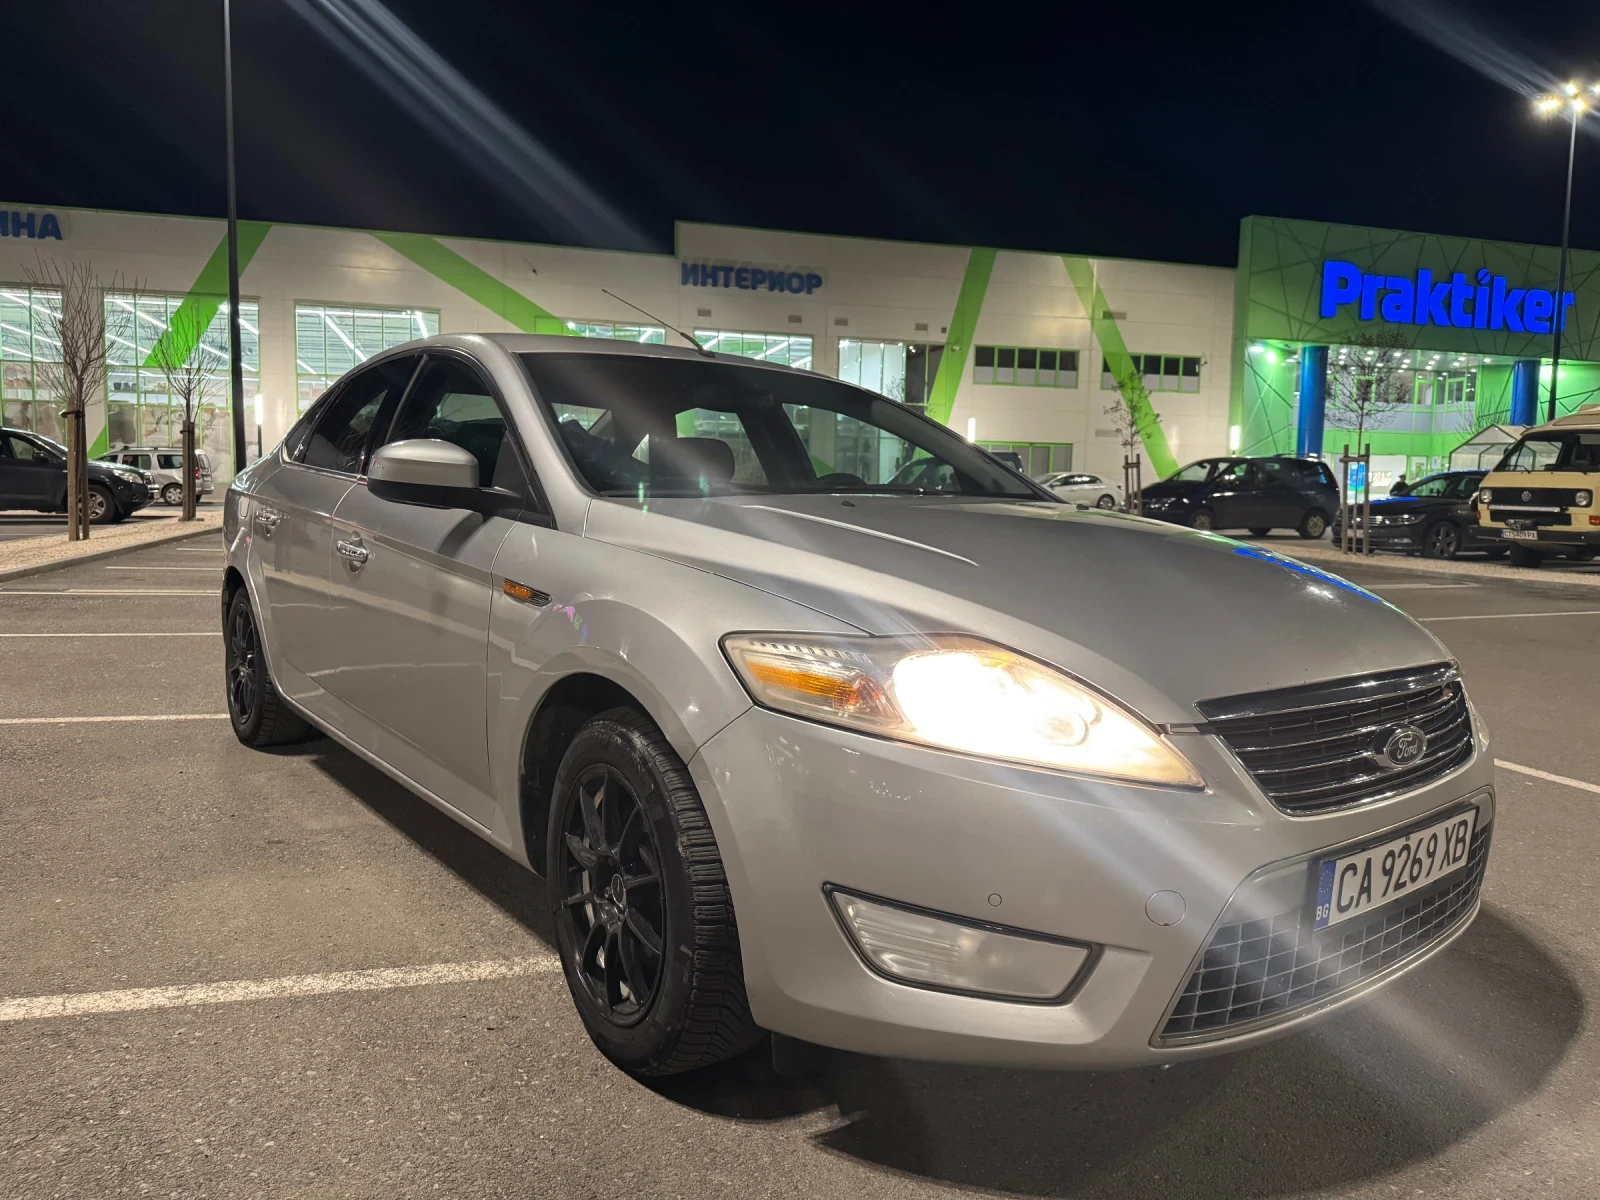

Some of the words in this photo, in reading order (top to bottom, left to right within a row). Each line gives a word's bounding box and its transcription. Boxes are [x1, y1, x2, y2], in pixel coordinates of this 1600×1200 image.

[681, 262, 823, 295] ИНТЕРИОР
[1320, 260, 1574, 334] Praktiker
[1396, 733, 1418, 760] Ford
[1336, 857, 1373, 914] CA
[1381, 832, 1438, 898] 9269
[1438, 818, 1470, 873] XB
[1315, 903, 1330, 922] BG
